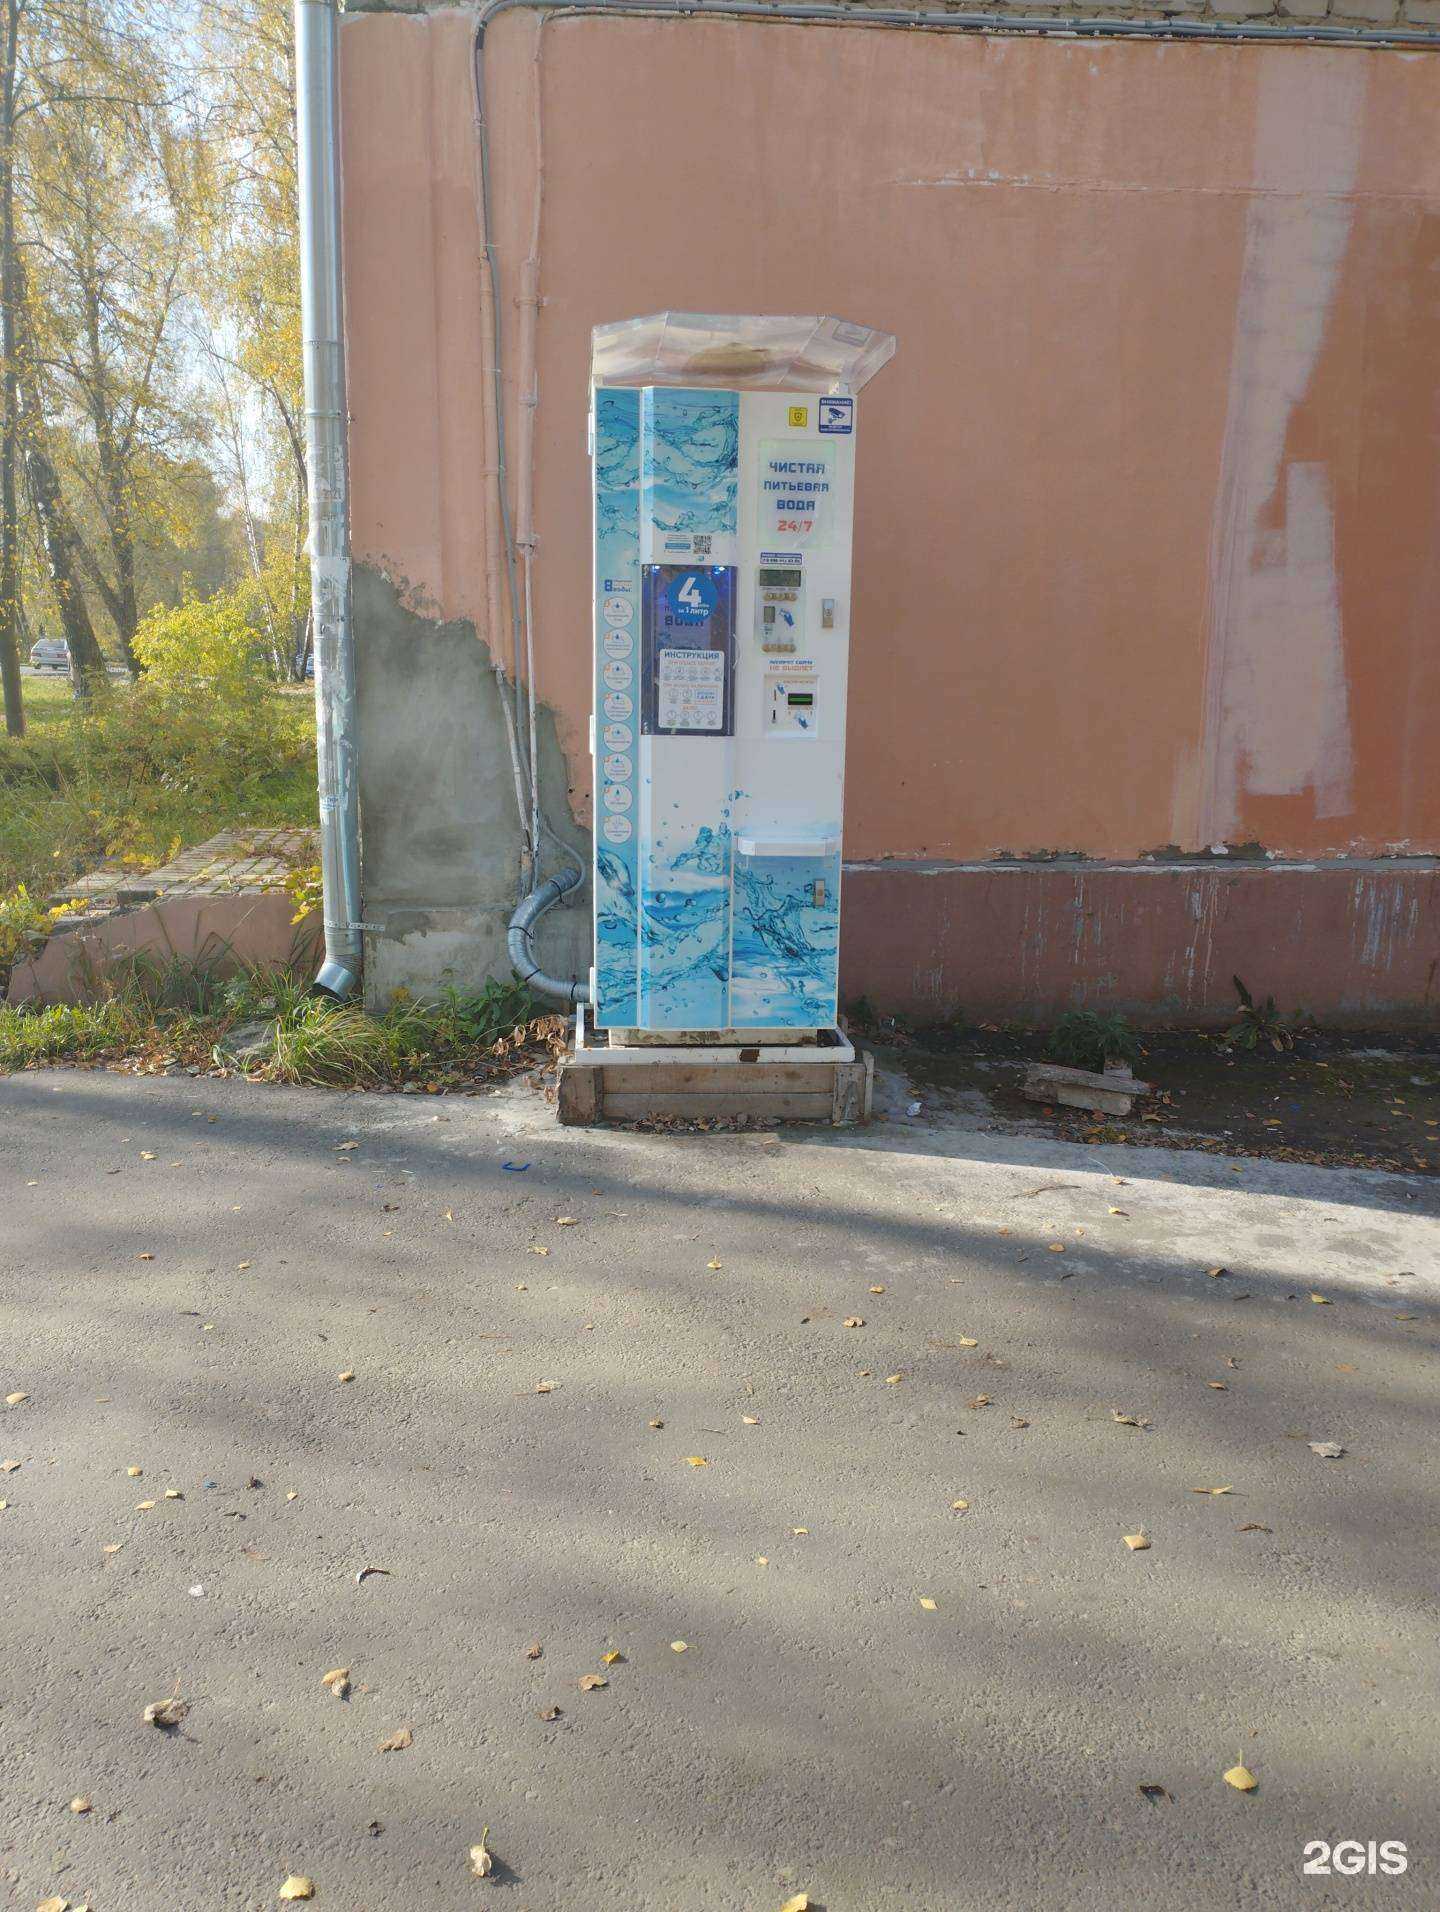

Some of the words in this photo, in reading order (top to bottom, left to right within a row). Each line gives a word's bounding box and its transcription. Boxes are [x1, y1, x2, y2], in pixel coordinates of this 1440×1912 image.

[769, 461, 825, 474] ЧИСТАЯ
[763, 480, 829, 492] ПИТЬЕВАЯ
[776, 499, 816, 511] ВОДА
[777, 519, 813, 533] 24/7
[678, 577, 702, 608] 4
[690, 608, 709, 617] литр
[664, 651, 720, 660] ИНСТРУКЦИЯ
